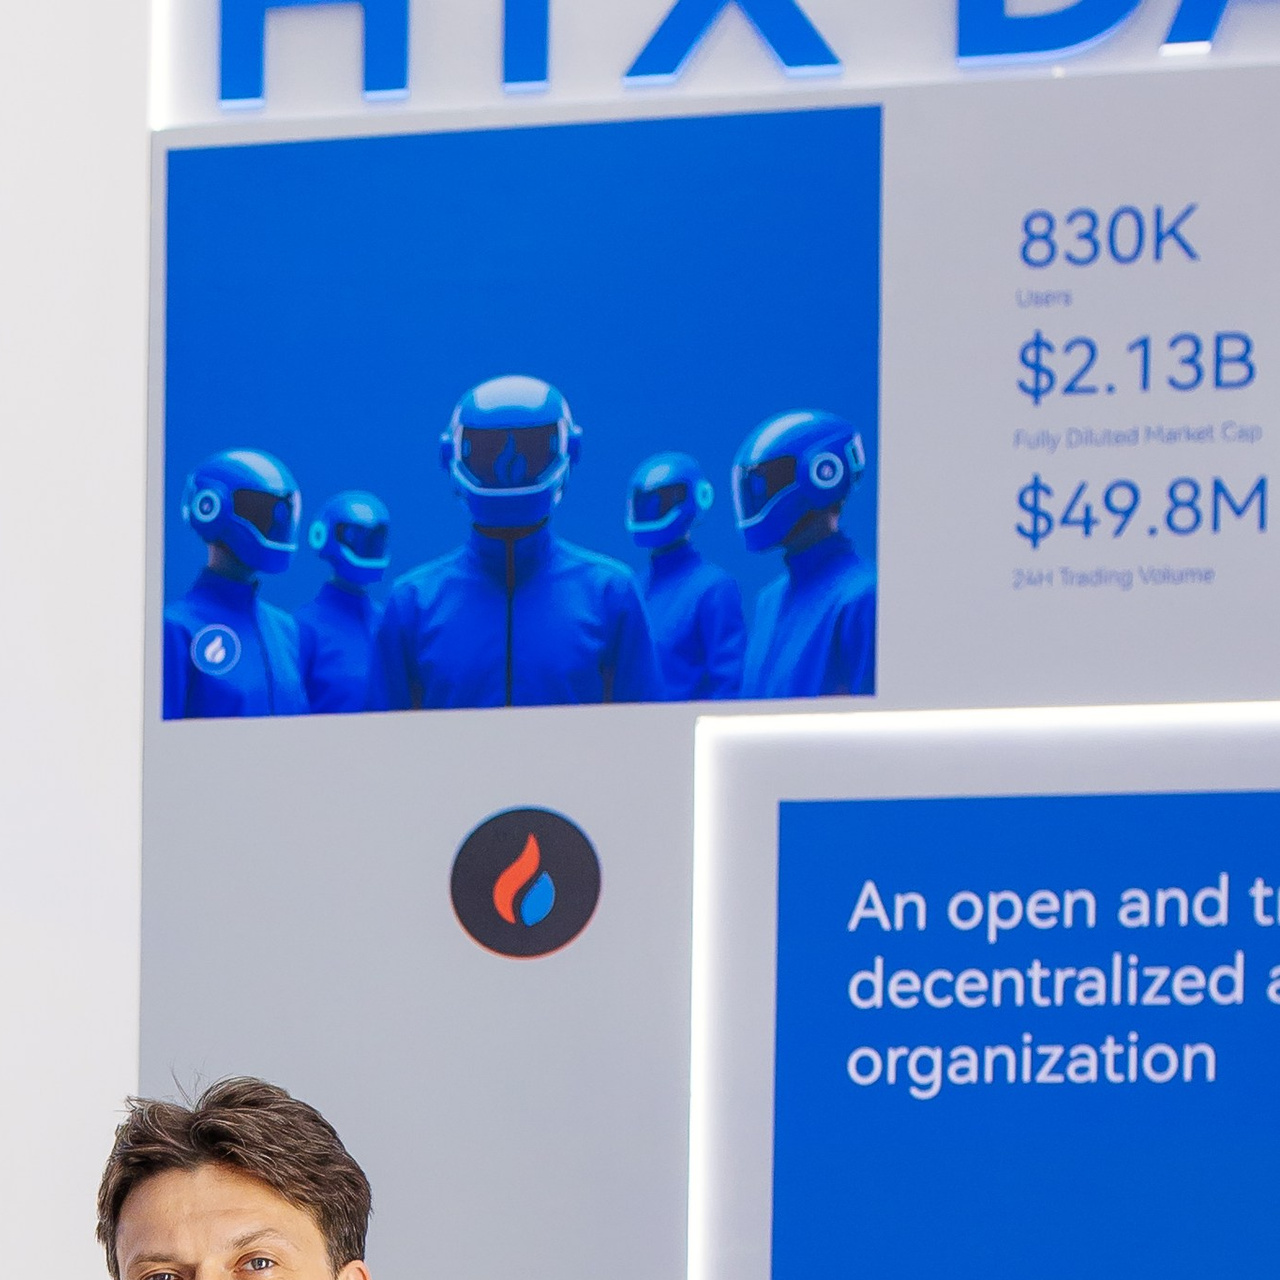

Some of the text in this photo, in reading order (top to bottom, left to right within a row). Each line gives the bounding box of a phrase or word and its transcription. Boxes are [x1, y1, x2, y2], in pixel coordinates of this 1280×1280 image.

[1021, 203, 1200, 268] 830K
[1018, 329, 1257, 407] $2.13B
[1144, 422, 1215, 446] Market
[1220, 419, 1263, 445] Cap
[1017, 472, 1268, 550] $49.8M
[1137, 565, 1217, 585] Volume
[847, 871, 1280, 945] An open and t
[847, 949, 1245, 1010] decentralized
[846, 1032, 1217, 1099] organization
